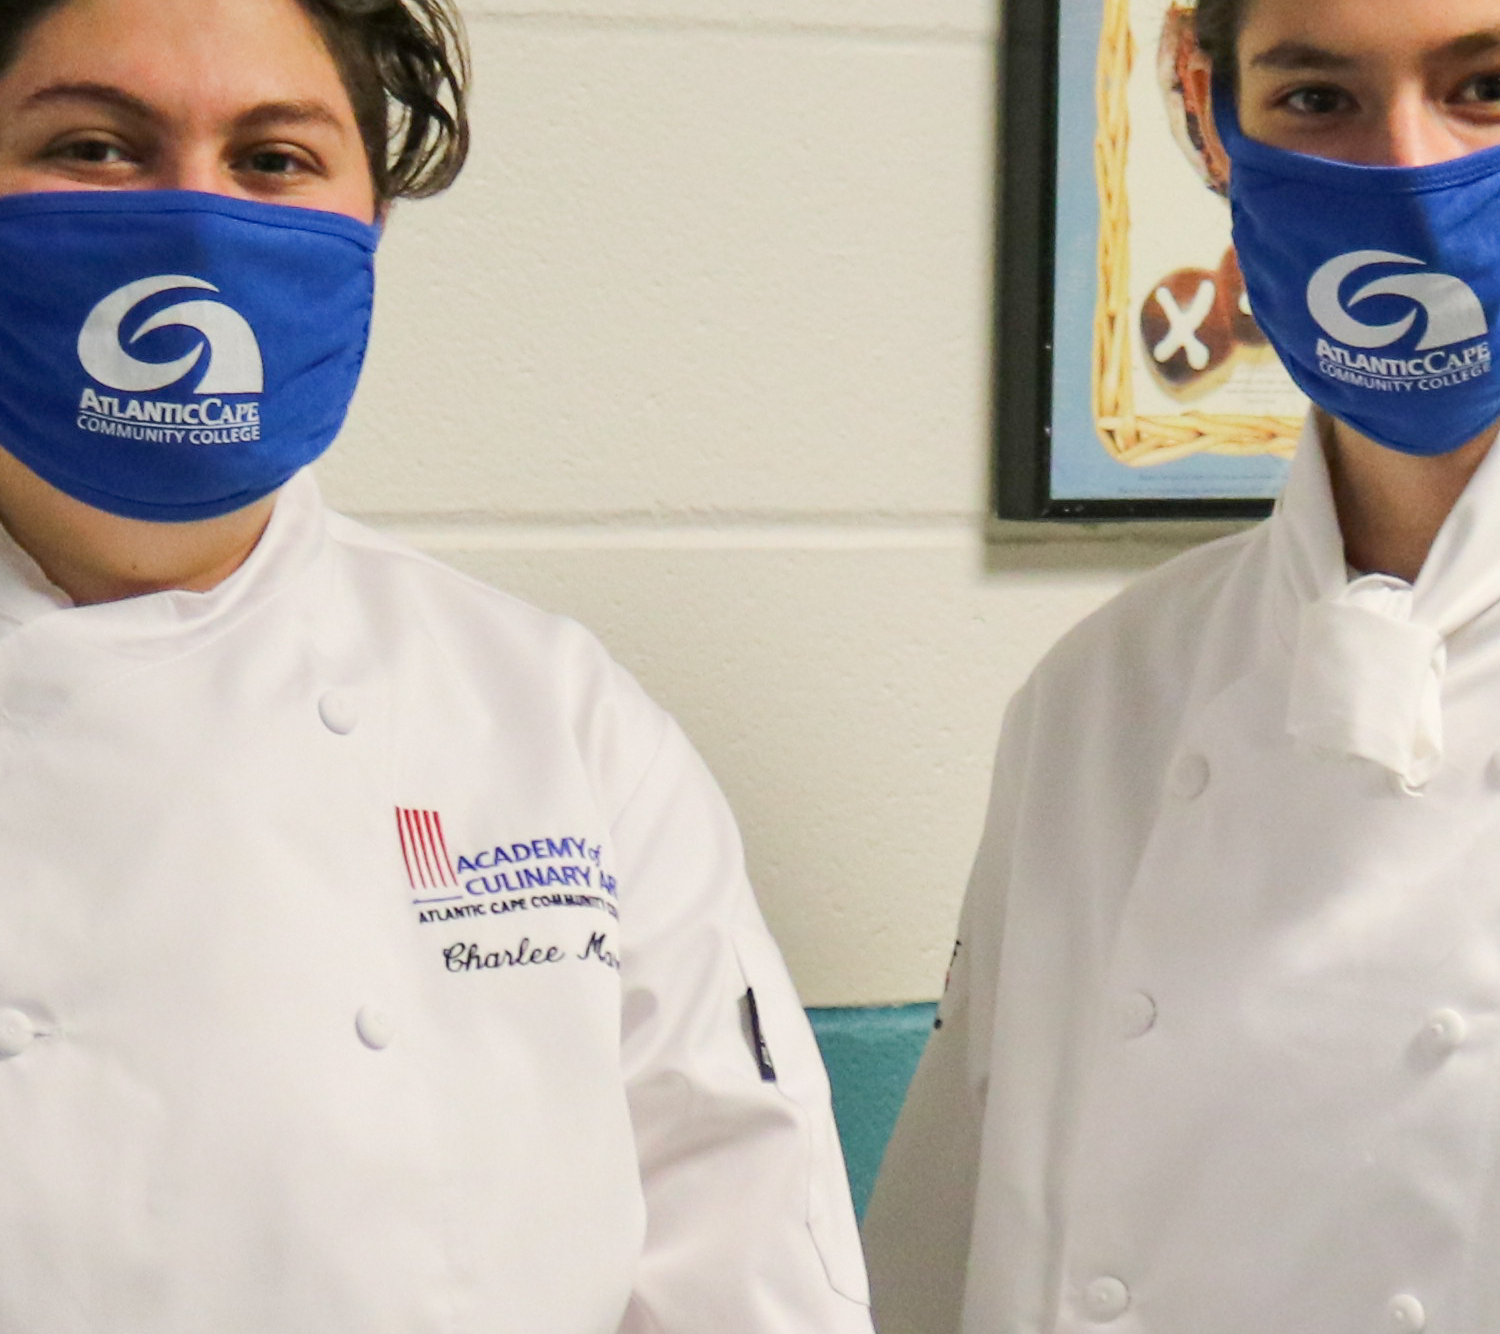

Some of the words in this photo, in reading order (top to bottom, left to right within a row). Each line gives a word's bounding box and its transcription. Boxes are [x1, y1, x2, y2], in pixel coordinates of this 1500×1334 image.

[1319, 360, 1413, 392] COMMUNITY
[1417, 362, 1492, 391] COLLEGE
[77, 415, 186, 443] COMMUNITY
[189, 425, 261, 445] COLLEGE
[456, 836, 586, 874] ACADEMY
[465, 865, 591, 896] CULINARY
[418, 901, 486, 924] ATLANTIC
[490, 897, 526, 916] CAPE
[443, 937, 565, 972] Charlee
